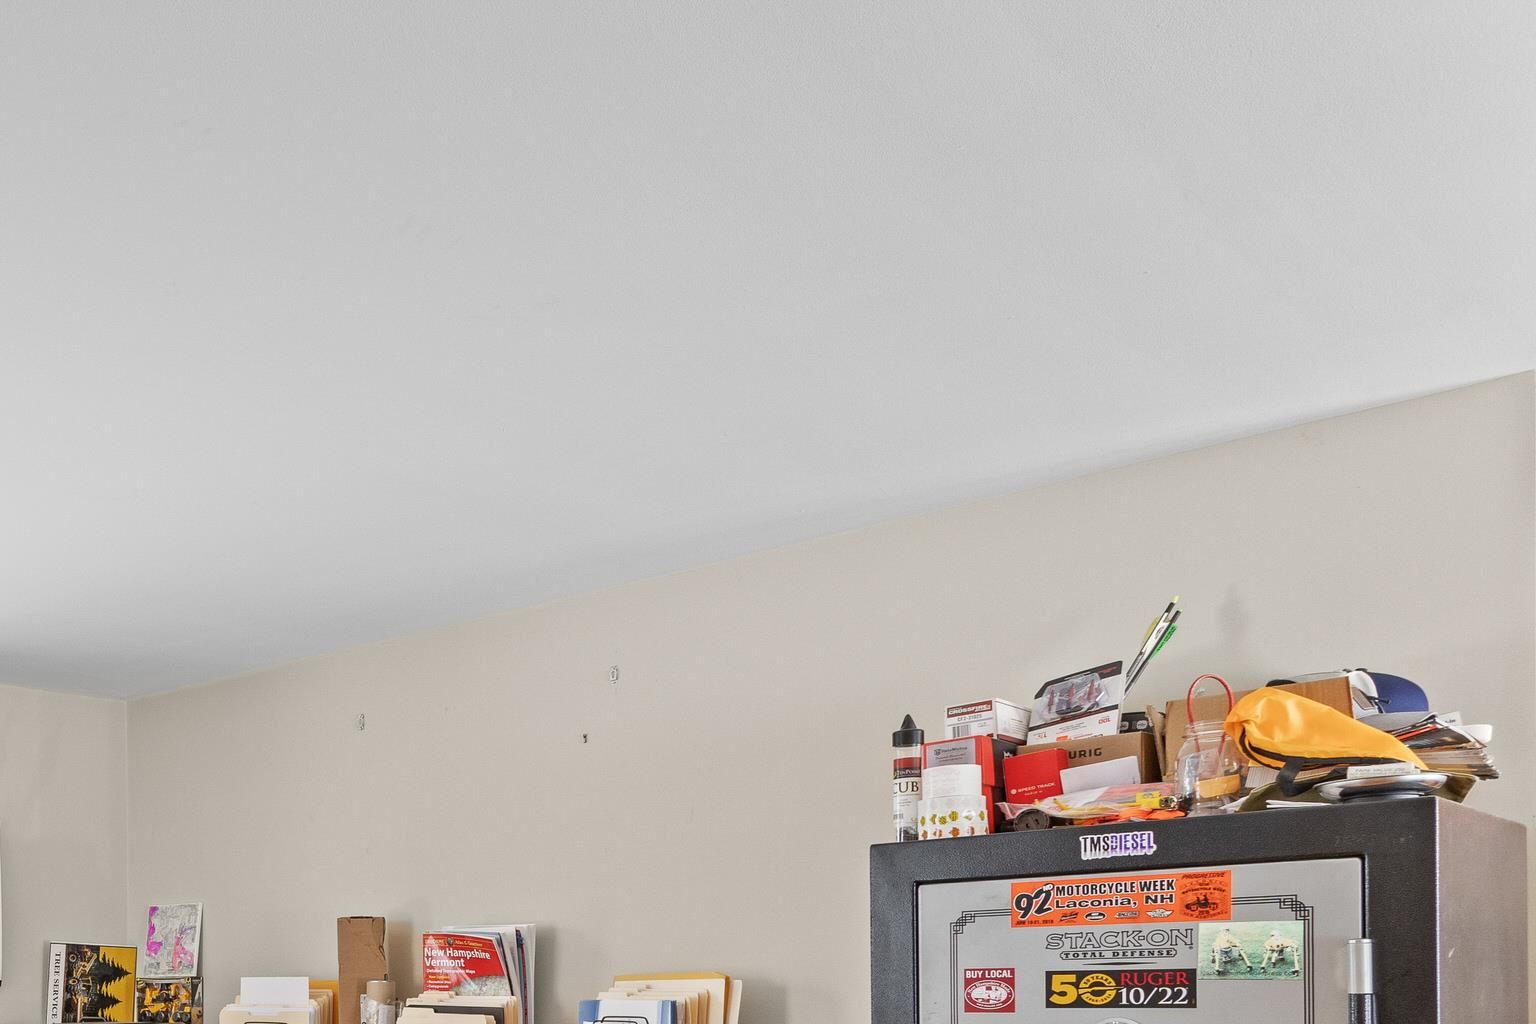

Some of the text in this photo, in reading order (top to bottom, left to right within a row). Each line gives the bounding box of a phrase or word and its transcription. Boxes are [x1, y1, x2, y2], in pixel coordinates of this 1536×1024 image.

[1068, 748, 1102, 759] URIG
[1082, 832, 1155, 851] TMSDIESEL
[1056, 881, 1136, 896] MOTORCYCLE
[1139, 879, 1175, 892] WEEK
[1015, 886, 1053, 919] 92
[1056, 894, 1174, 909] Laconia, NH
[1046, 928, 1194, 949] STACK-ON
[424, 948, 491, 960] New Hampshire
[1112, 949, 1173, 958] DEFENSE
[424, 957, 465, 967] Vermont
[966, 970, 1013, 978] BUY LOCAL
[1120, 971, 1189, 986] RUGER
[51, 979, 60, 1020] SERVICE
[1118, 987, 1189, 1005] 10/22
